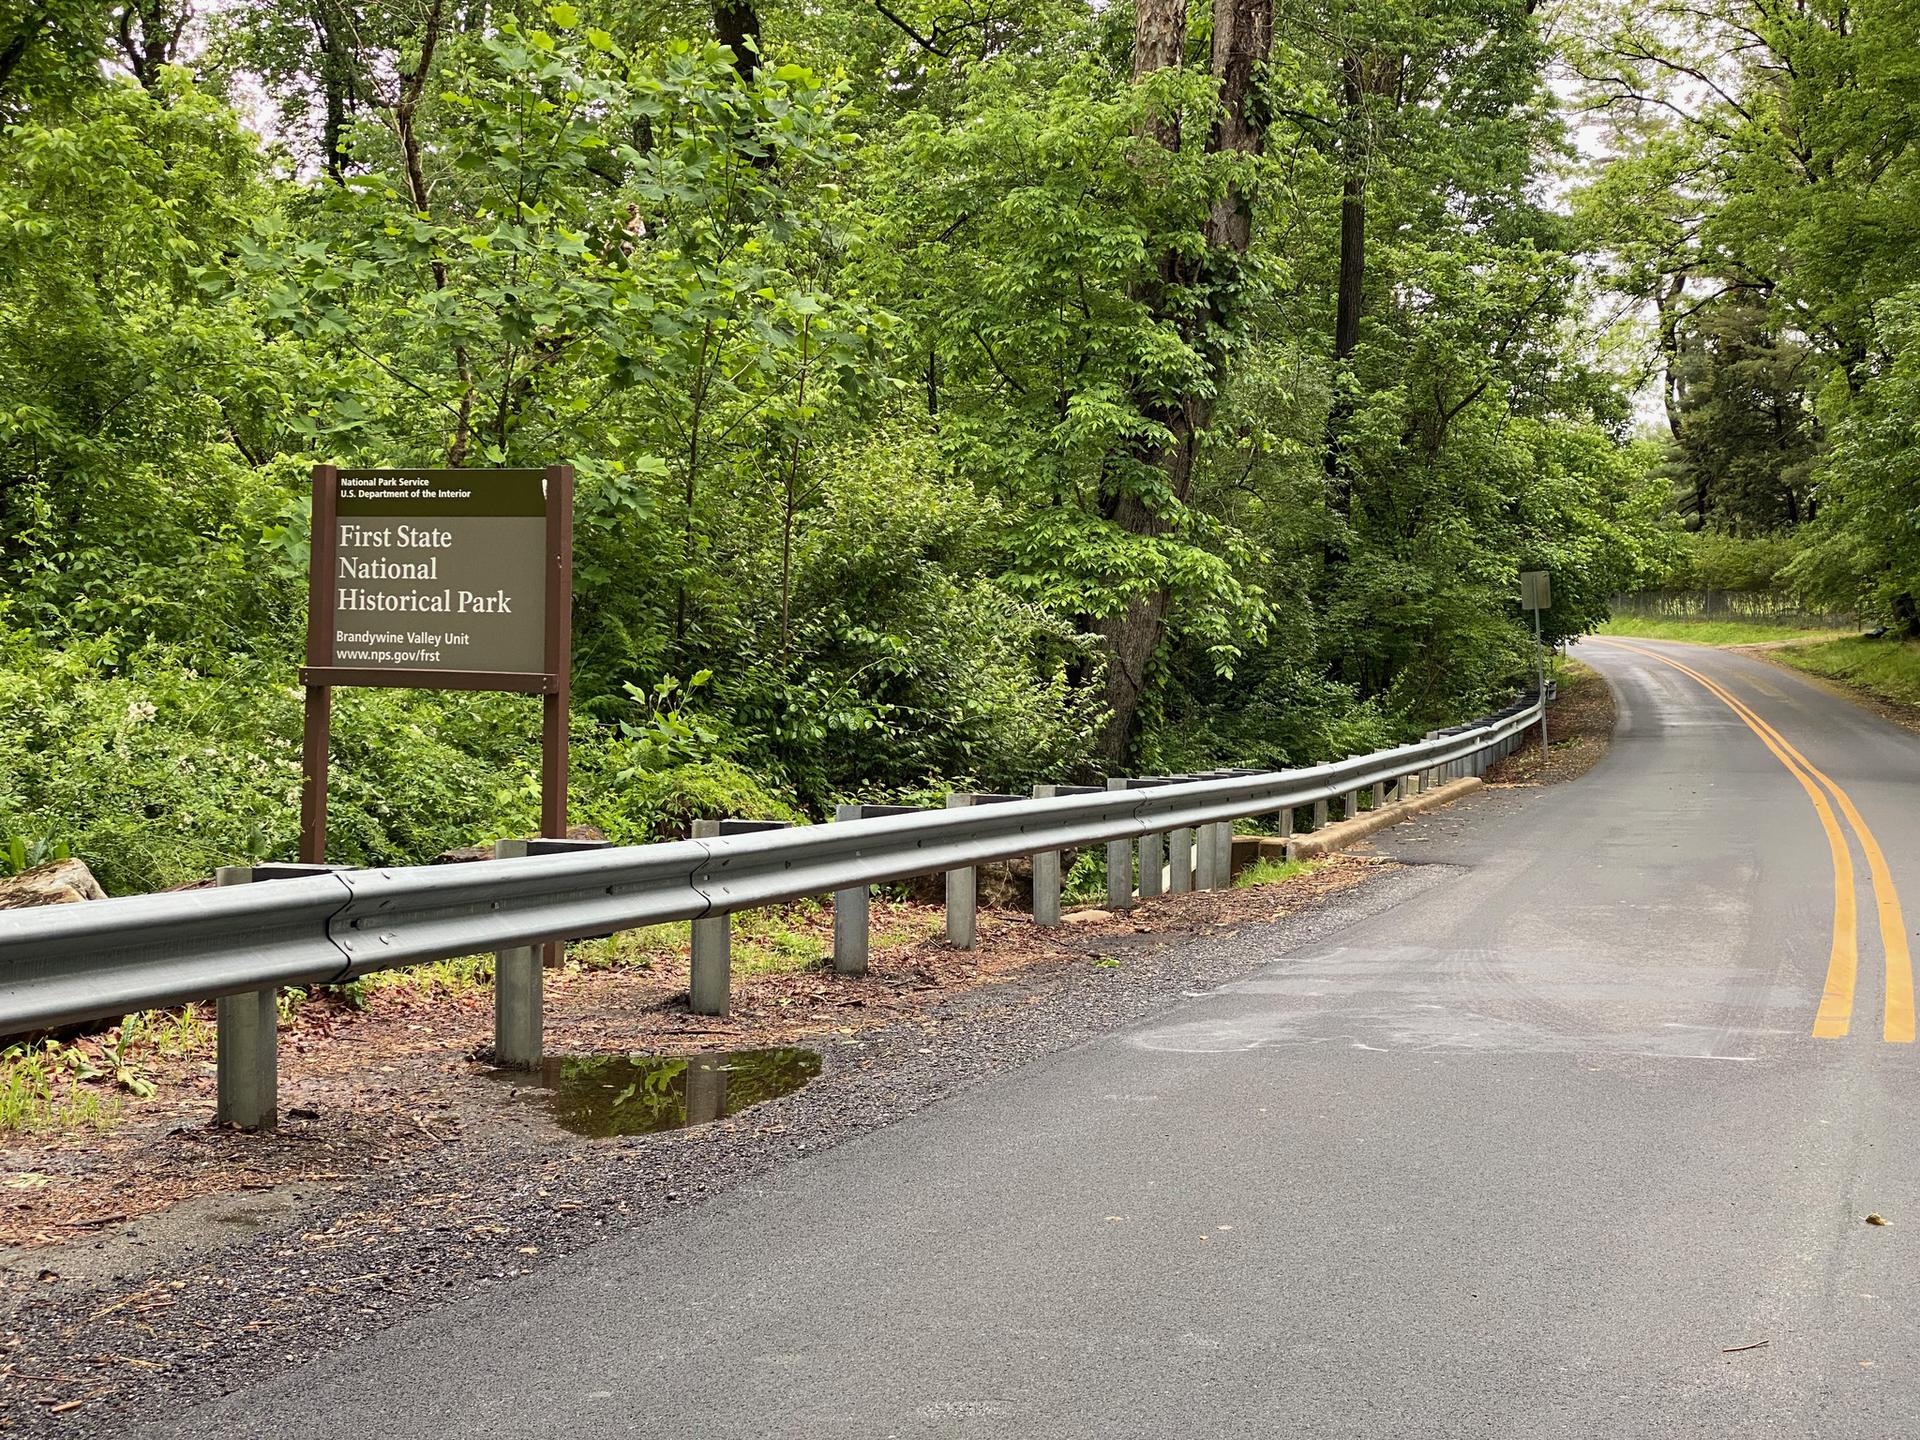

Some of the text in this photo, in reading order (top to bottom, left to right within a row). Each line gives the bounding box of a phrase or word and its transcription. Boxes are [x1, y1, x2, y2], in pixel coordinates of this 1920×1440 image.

[341, 477, 430, 487] National Park Service
[341, 489, 472, 500] U.S. Department of the Interior
[339, 525, 452, 548] First State
[338, 556, 438, 580] National
[337, 588, 512, 613] Historical Park
[336, 630, 470, 648] Brandywine Valley Unit
[336, 649, 441, 664] www.nps.gov/frst
